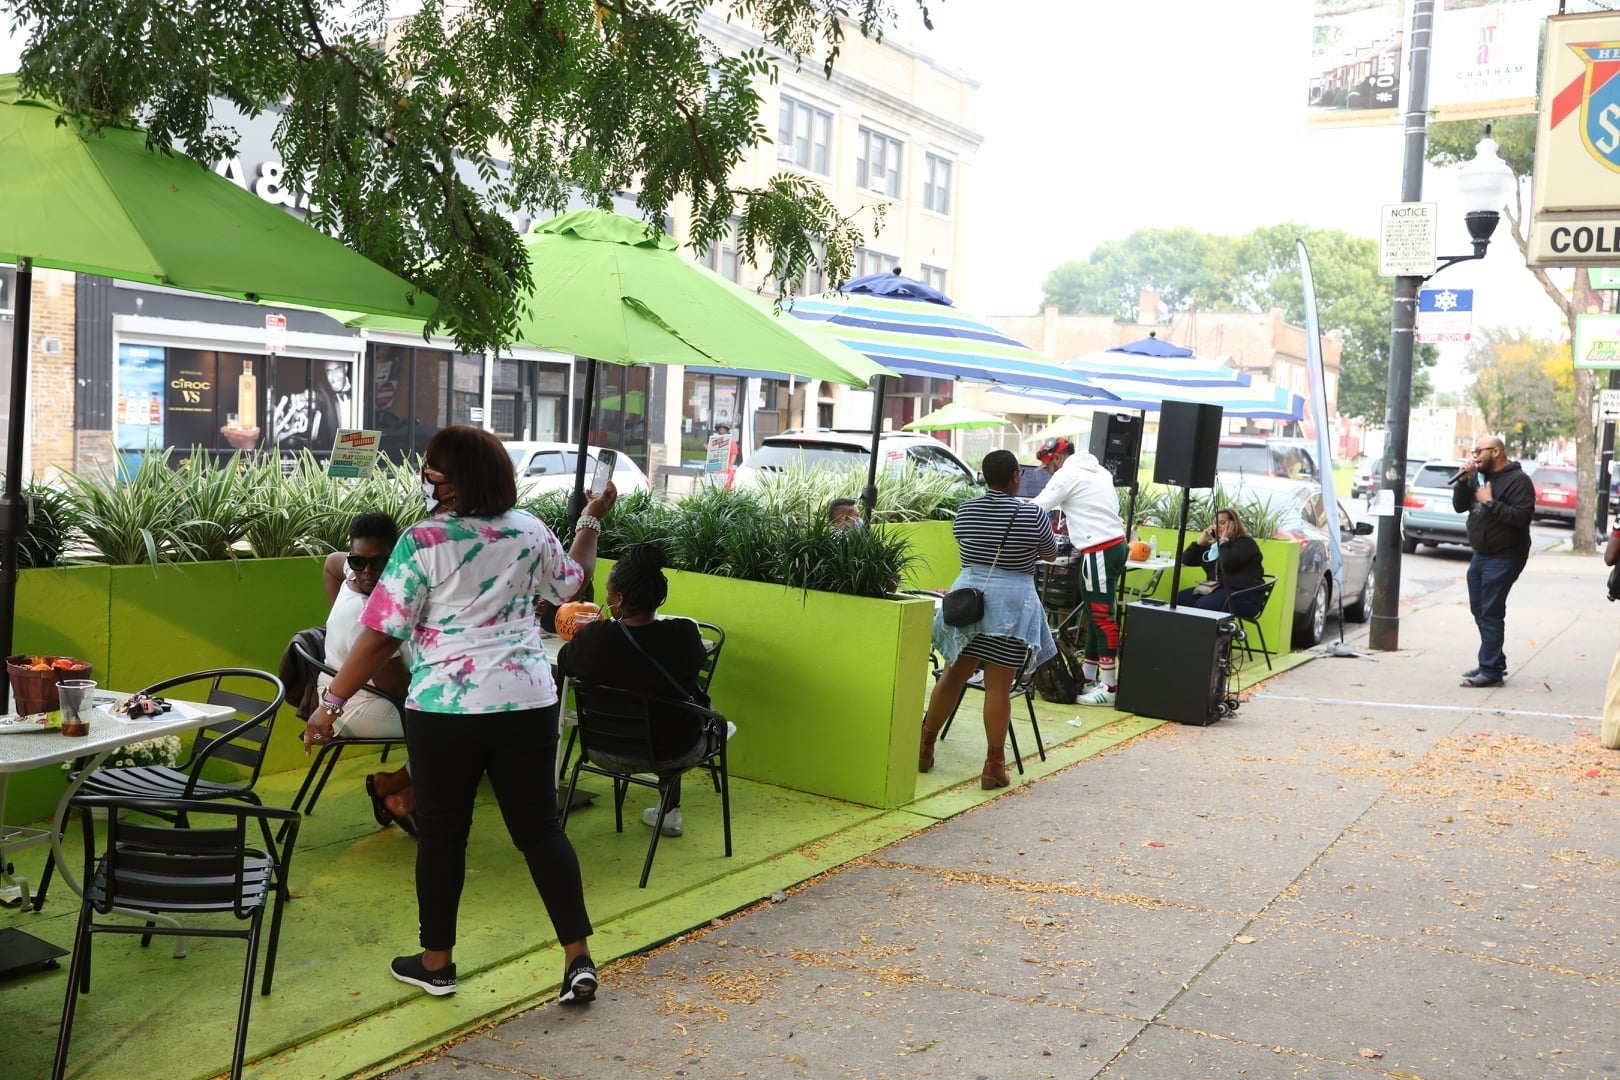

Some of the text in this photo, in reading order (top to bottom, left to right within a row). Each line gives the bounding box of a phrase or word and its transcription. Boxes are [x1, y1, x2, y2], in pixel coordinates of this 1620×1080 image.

[1456, 65, 1523, 80] CHATHAM
[1391, 207, 1428, 217] NOTICE
[182, 390, 201, 404] VS
